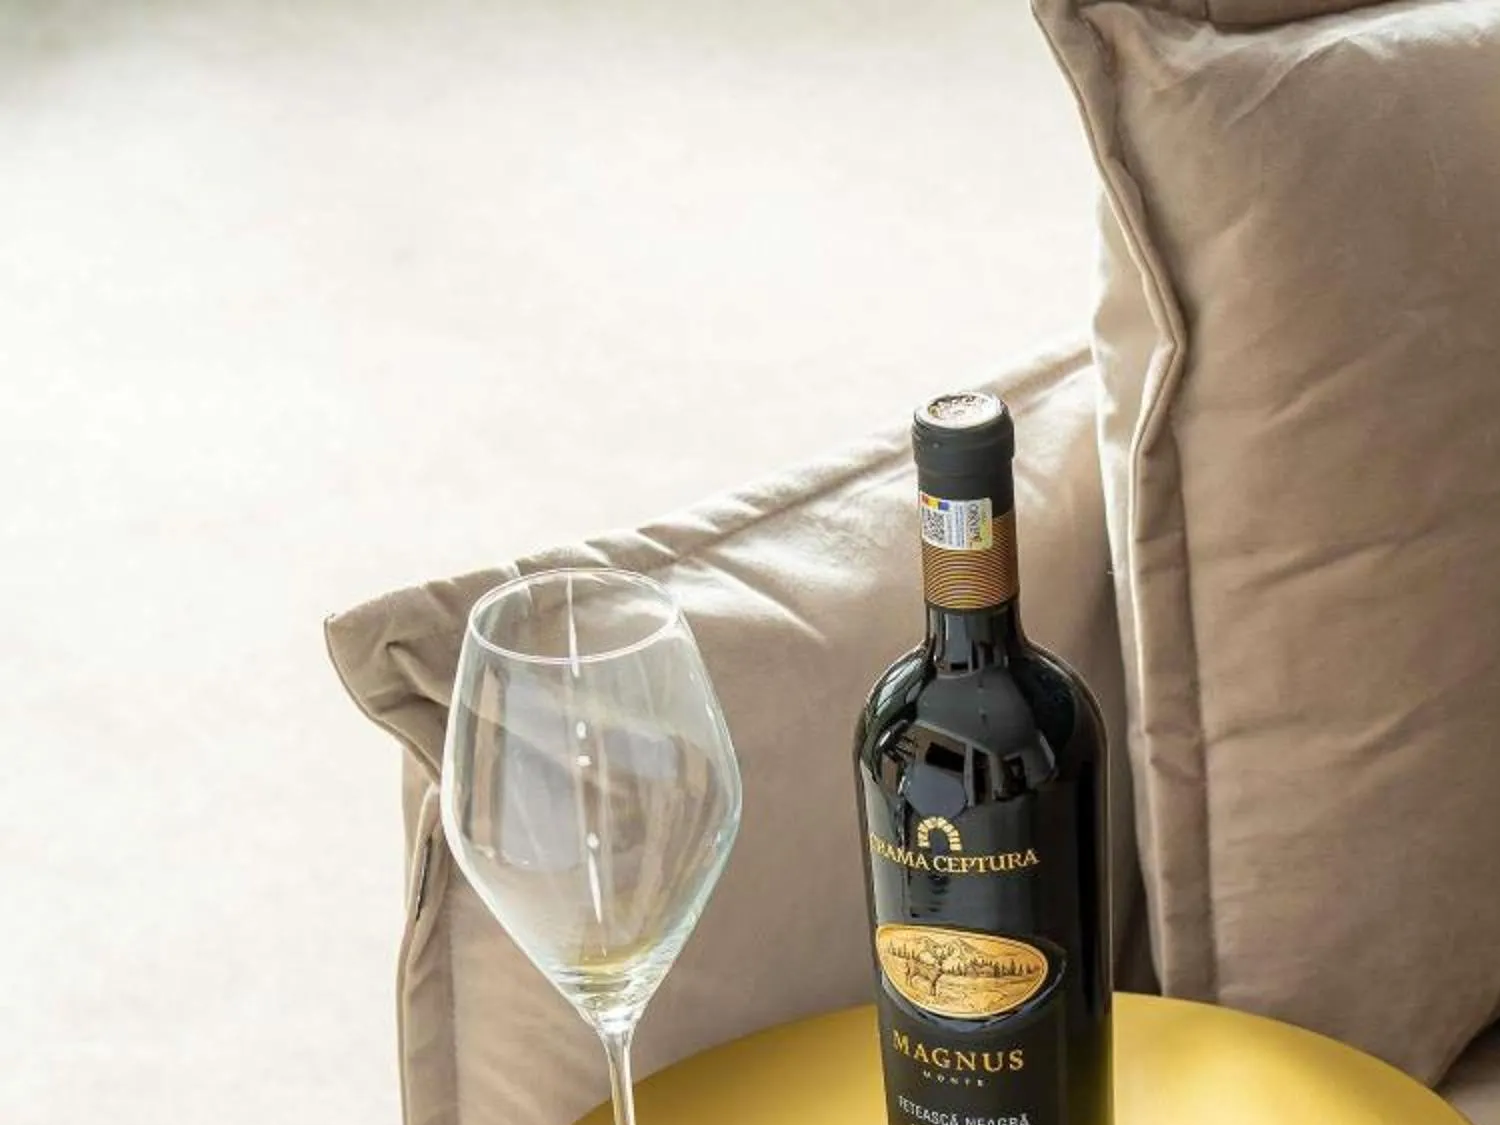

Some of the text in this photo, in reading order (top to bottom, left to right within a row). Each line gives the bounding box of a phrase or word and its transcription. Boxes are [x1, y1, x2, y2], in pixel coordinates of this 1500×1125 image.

[932, 848, 1041, 873] CEPTURA
[892, 1029, 1025, 1072] MAGNUS
[922, 1069, 985, 1087] MONTE
